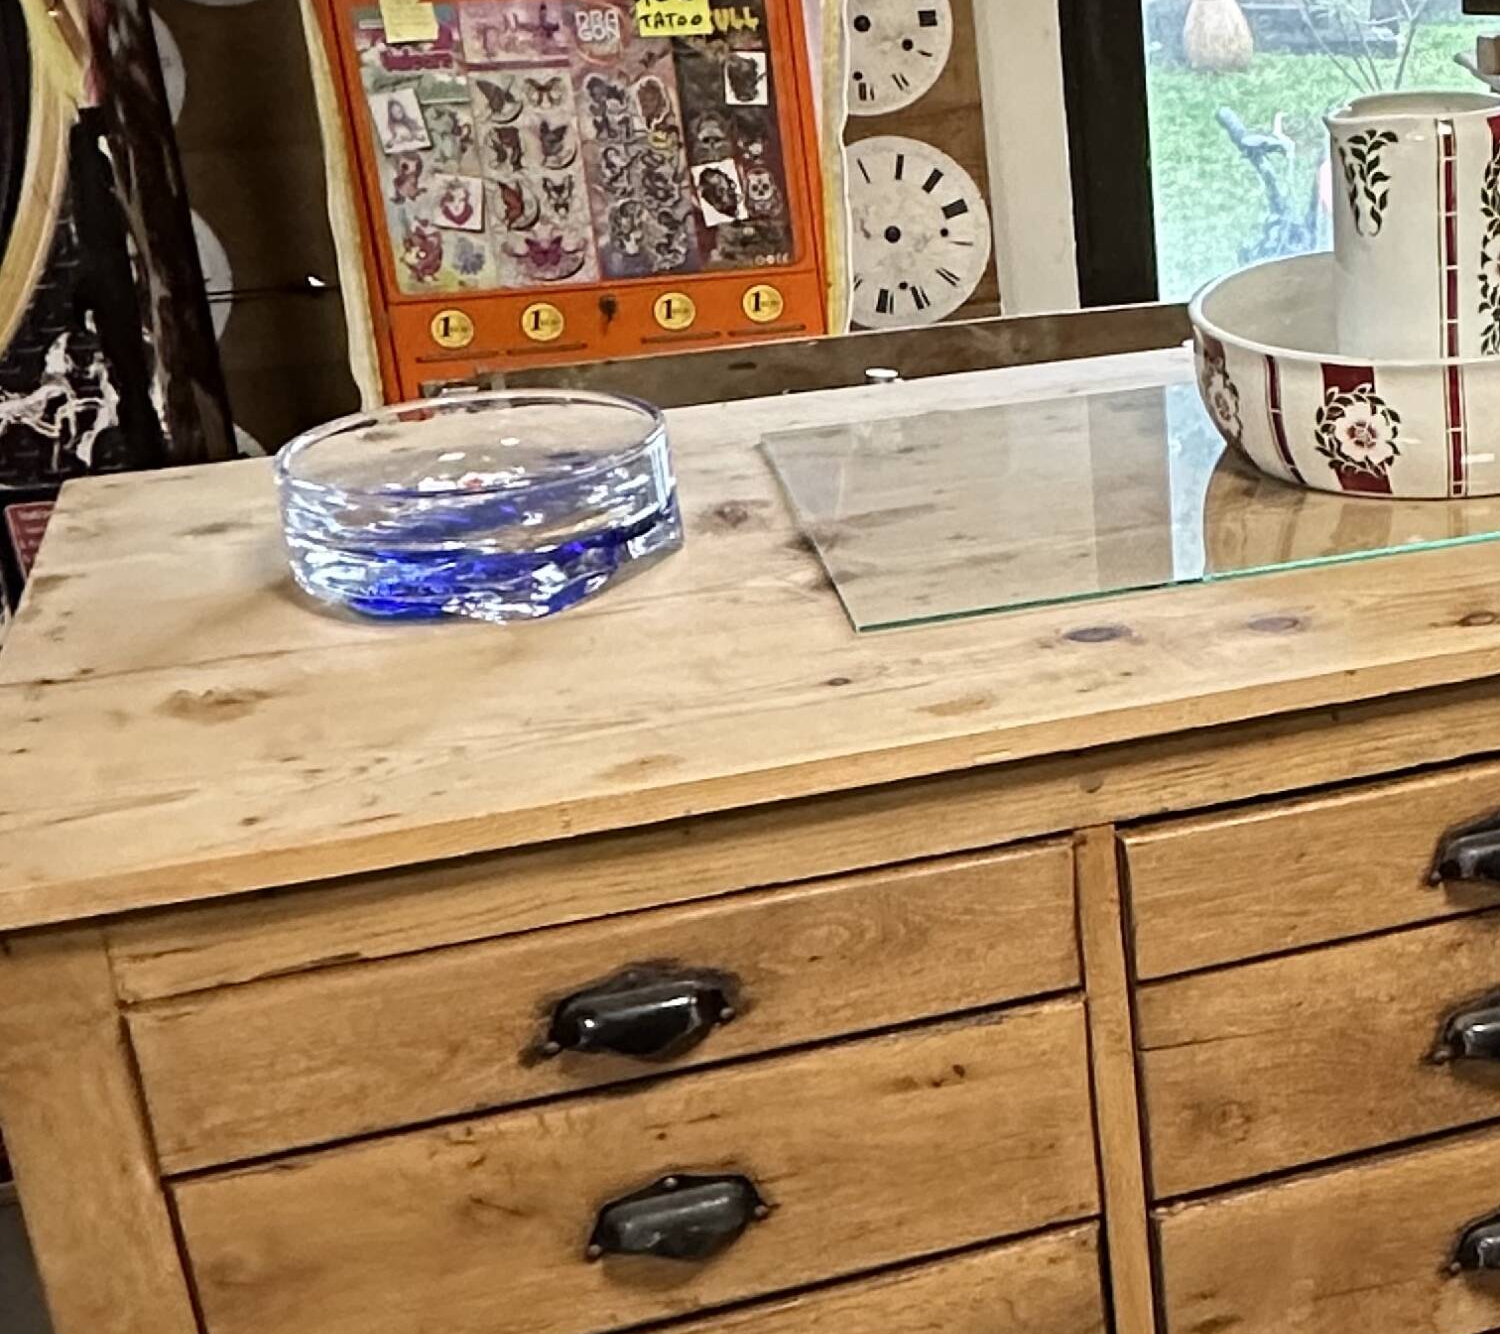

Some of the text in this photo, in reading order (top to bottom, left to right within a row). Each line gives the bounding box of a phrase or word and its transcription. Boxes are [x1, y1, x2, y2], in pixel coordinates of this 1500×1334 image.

[639, 13, 704, 29] TATOO
[711, 6, 759, 32] ULL
[664, 298, 673, 320] 1
[752, 290, 761, 312] 1
[440, 316, 450, 337] 1
[531, 310, 541, 331] 1
